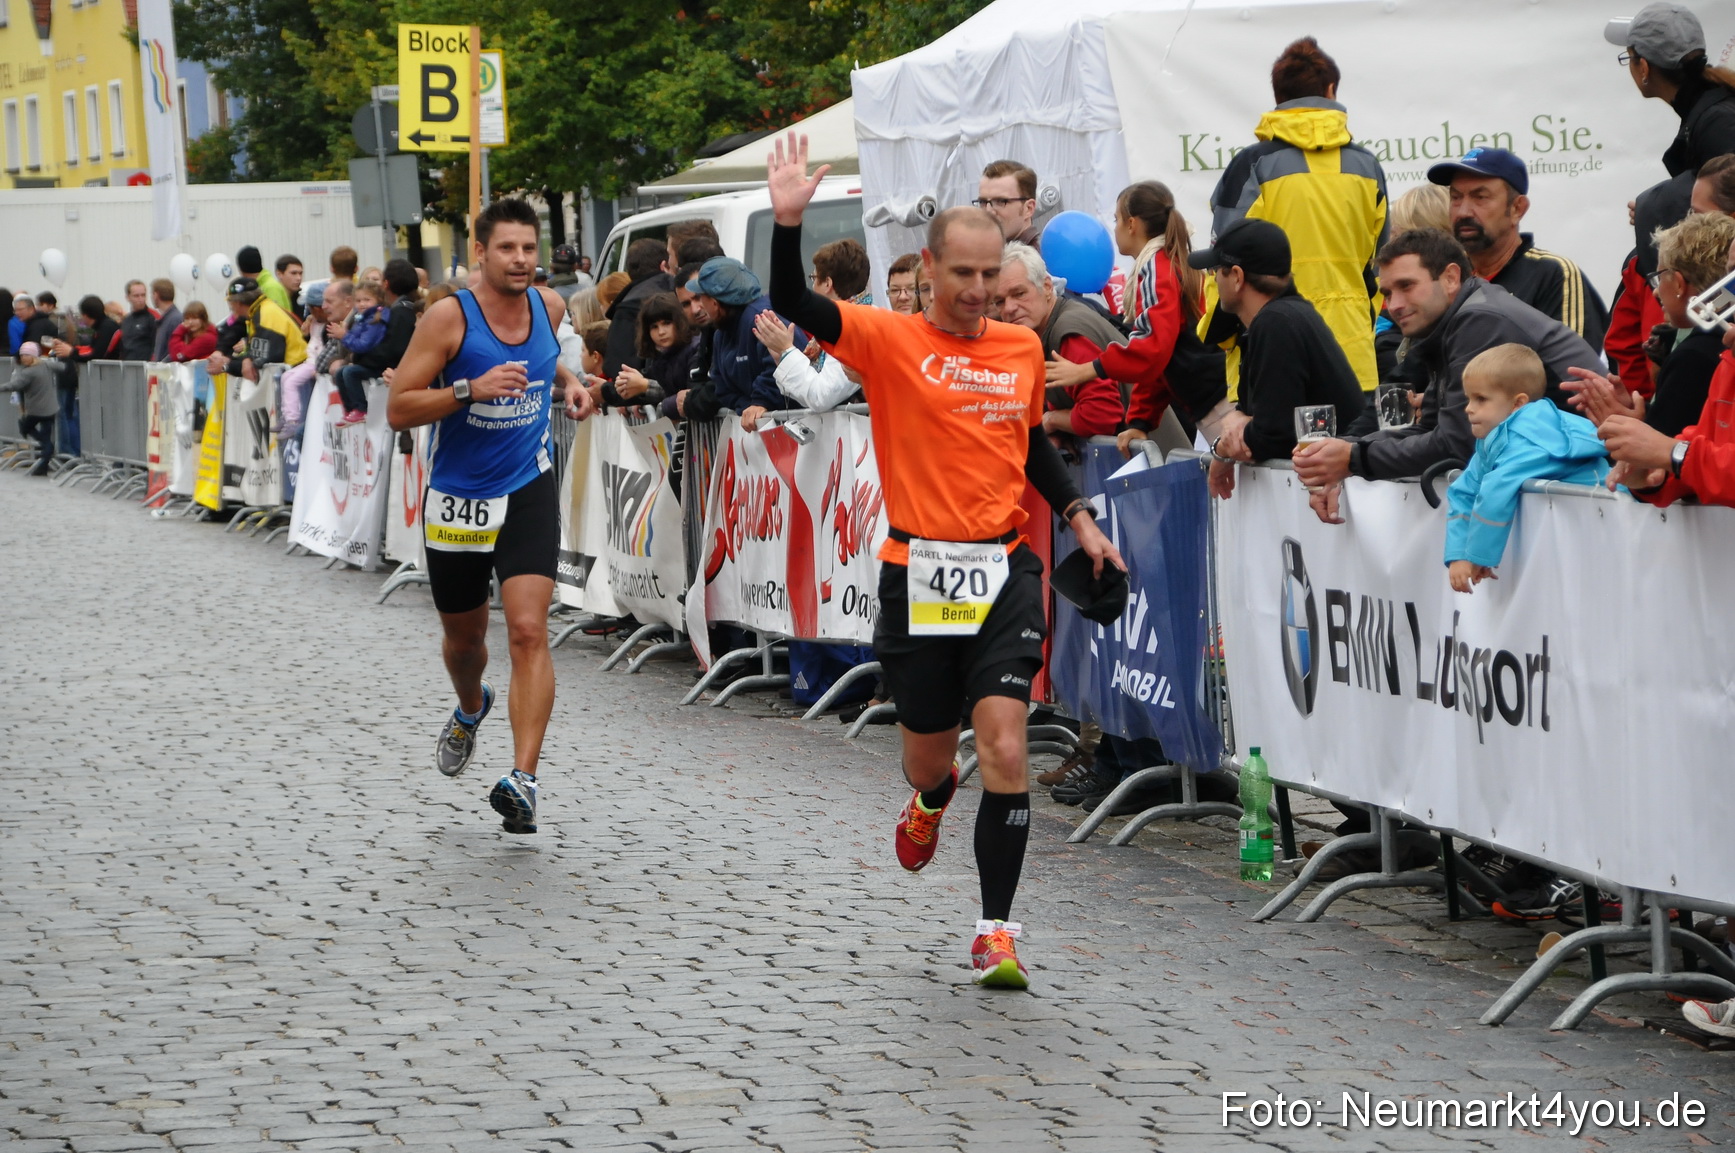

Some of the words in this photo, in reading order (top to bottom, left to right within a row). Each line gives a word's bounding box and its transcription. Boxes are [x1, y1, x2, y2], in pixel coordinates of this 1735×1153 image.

[409, 30, 470, 53] Block
[421, 64, 459, 122] B
[1358, 120, 1515, 163] rauchen
[1532, 114, 1603, 153] Sie.
[940, 362, 1018, 385] Fischer
[948, 382, 1015, 395] AUTOMOBILE
[961, 401, 980, 412] und
[981, 400, 999, 411] das
[441, 495, 489, 527] 346
[437, 529, 489, 542] Alexander
[911, 549, 942, 560] PARTL
[945, 552, 988, 563] Neumarkt
[929, 566, 988, 601] 420
[941, 606, 976, 621] Bernd
[1325, 588, 1402, 696] BMW
